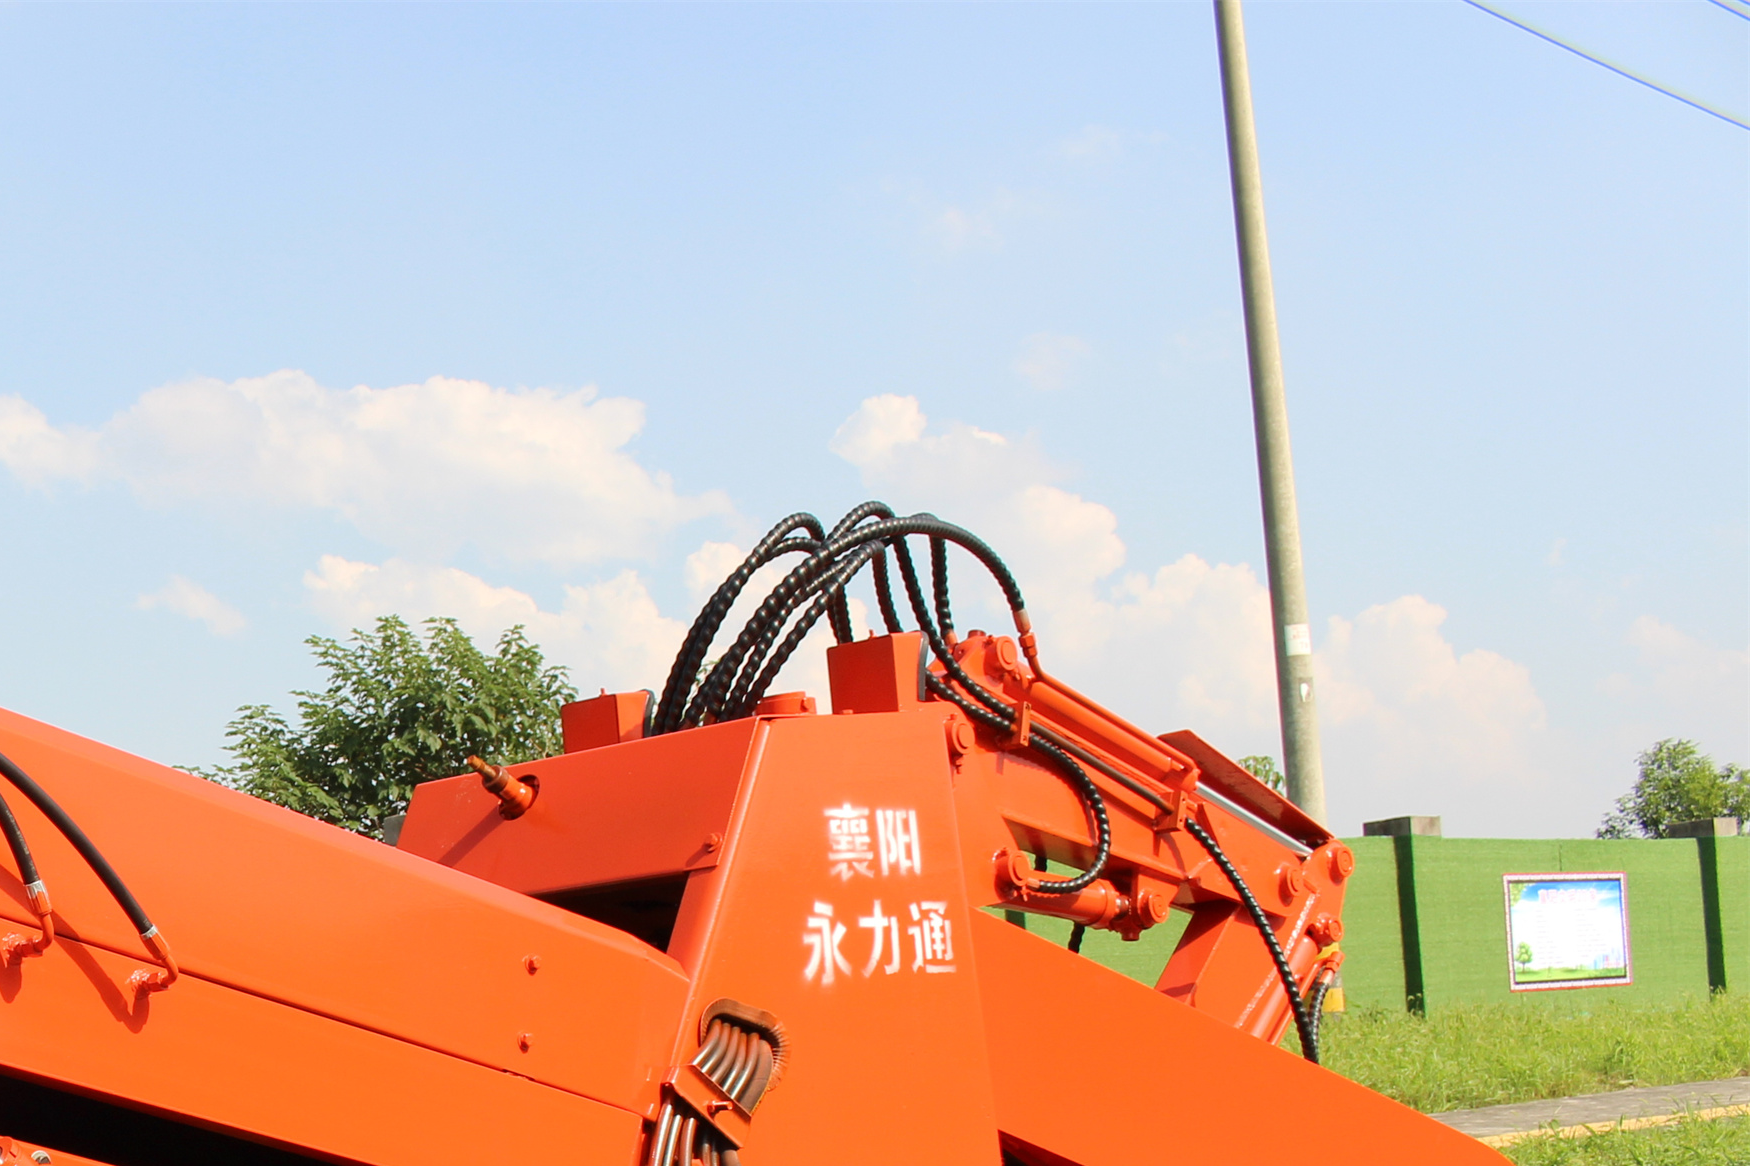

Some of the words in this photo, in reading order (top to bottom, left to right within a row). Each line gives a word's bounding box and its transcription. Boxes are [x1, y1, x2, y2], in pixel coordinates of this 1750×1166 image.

[823, 801, 922, 882] 襄阳
[803, 899, 956, 986] 永力通
